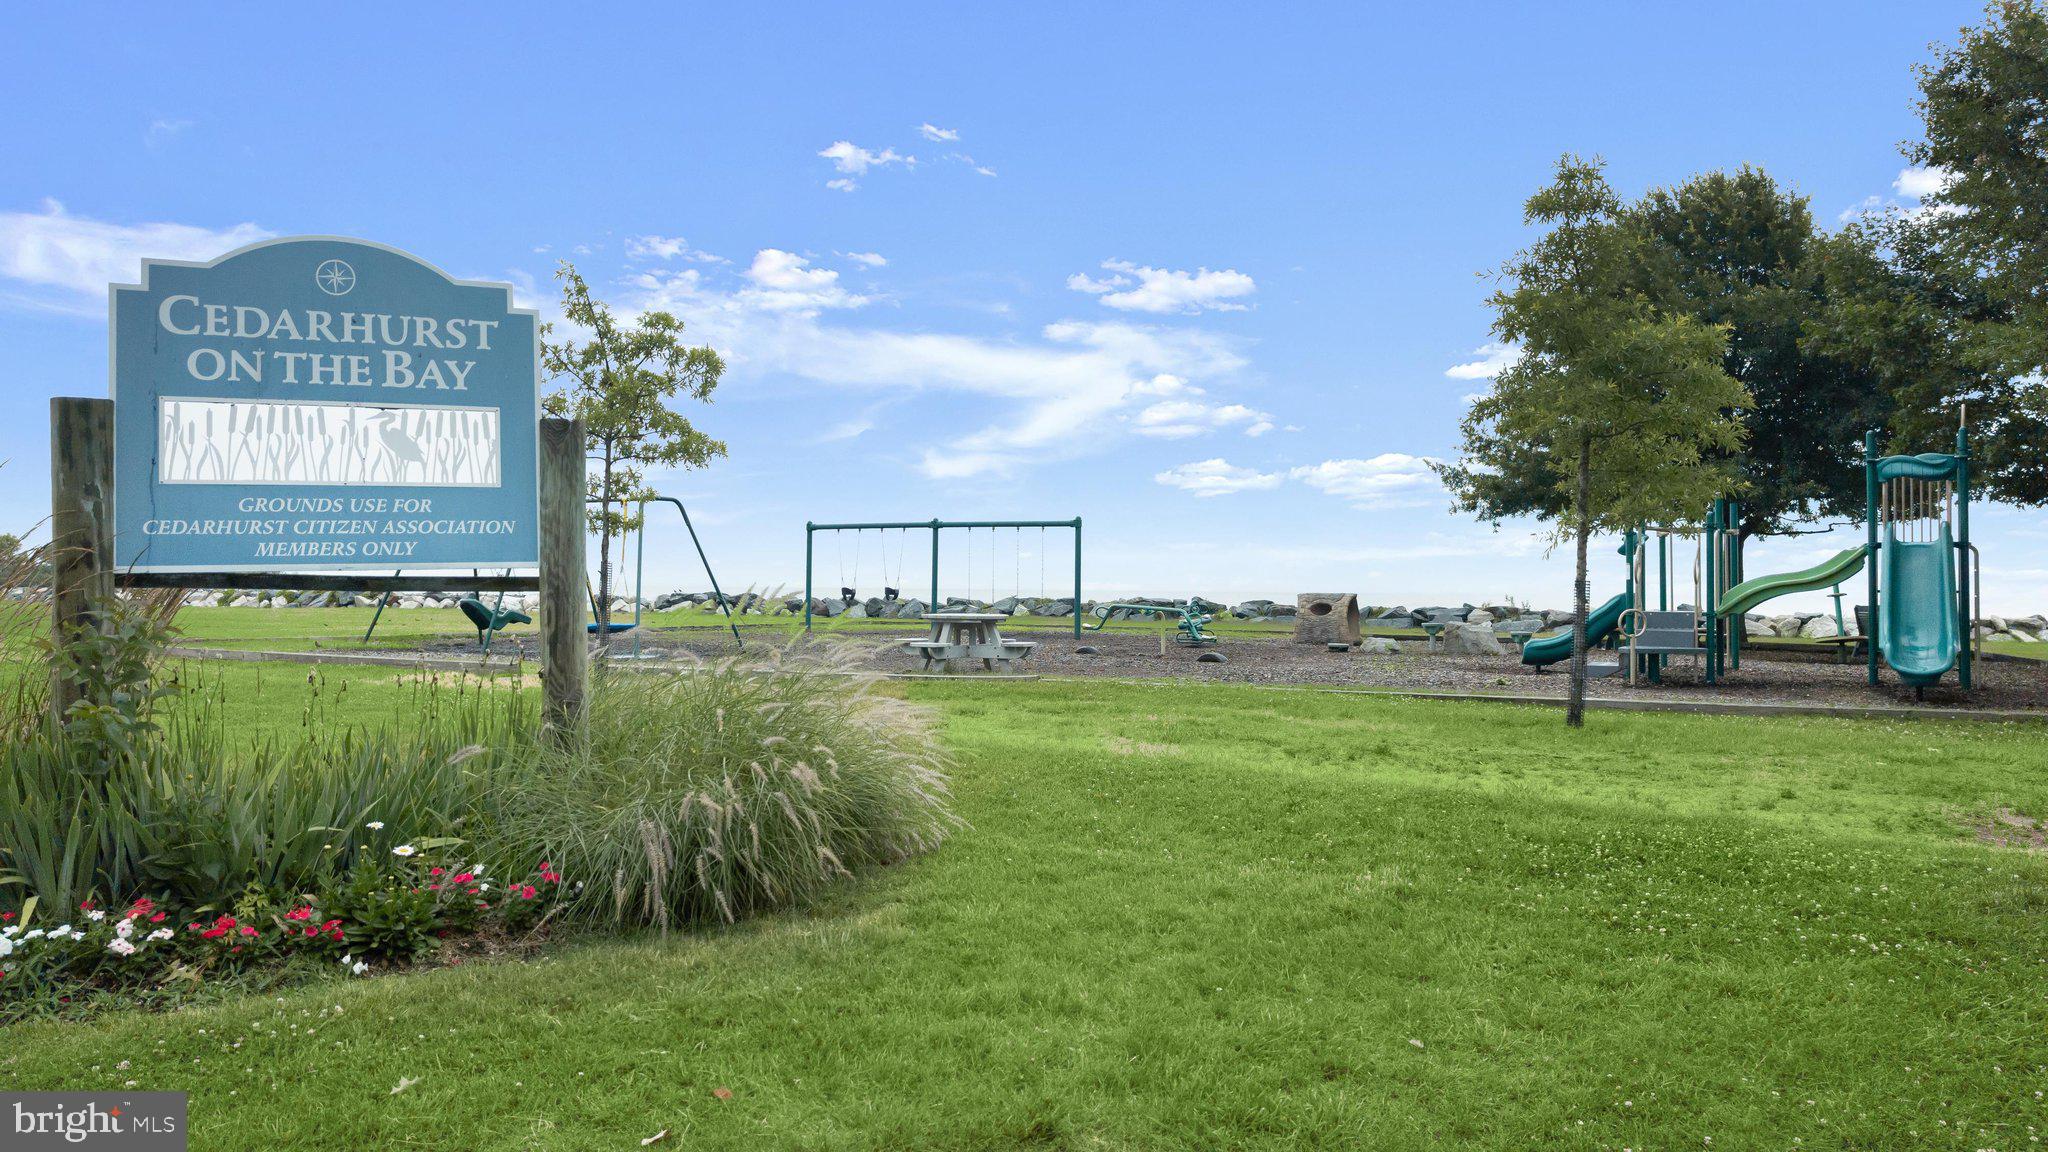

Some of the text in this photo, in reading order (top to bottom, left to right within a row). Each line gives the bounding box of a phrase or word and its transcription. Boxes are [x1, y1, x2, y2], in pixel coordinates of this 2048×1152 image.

[187, 347, 476, 391] ON THE BAY
[238, 497, 432, 513] GROUNDS USE FOR
[142, 519, 516, 536] CEDARHURST CITIZEN ASSOCIATION
[254, 541, 419, 558] MEMBERS ONLY
